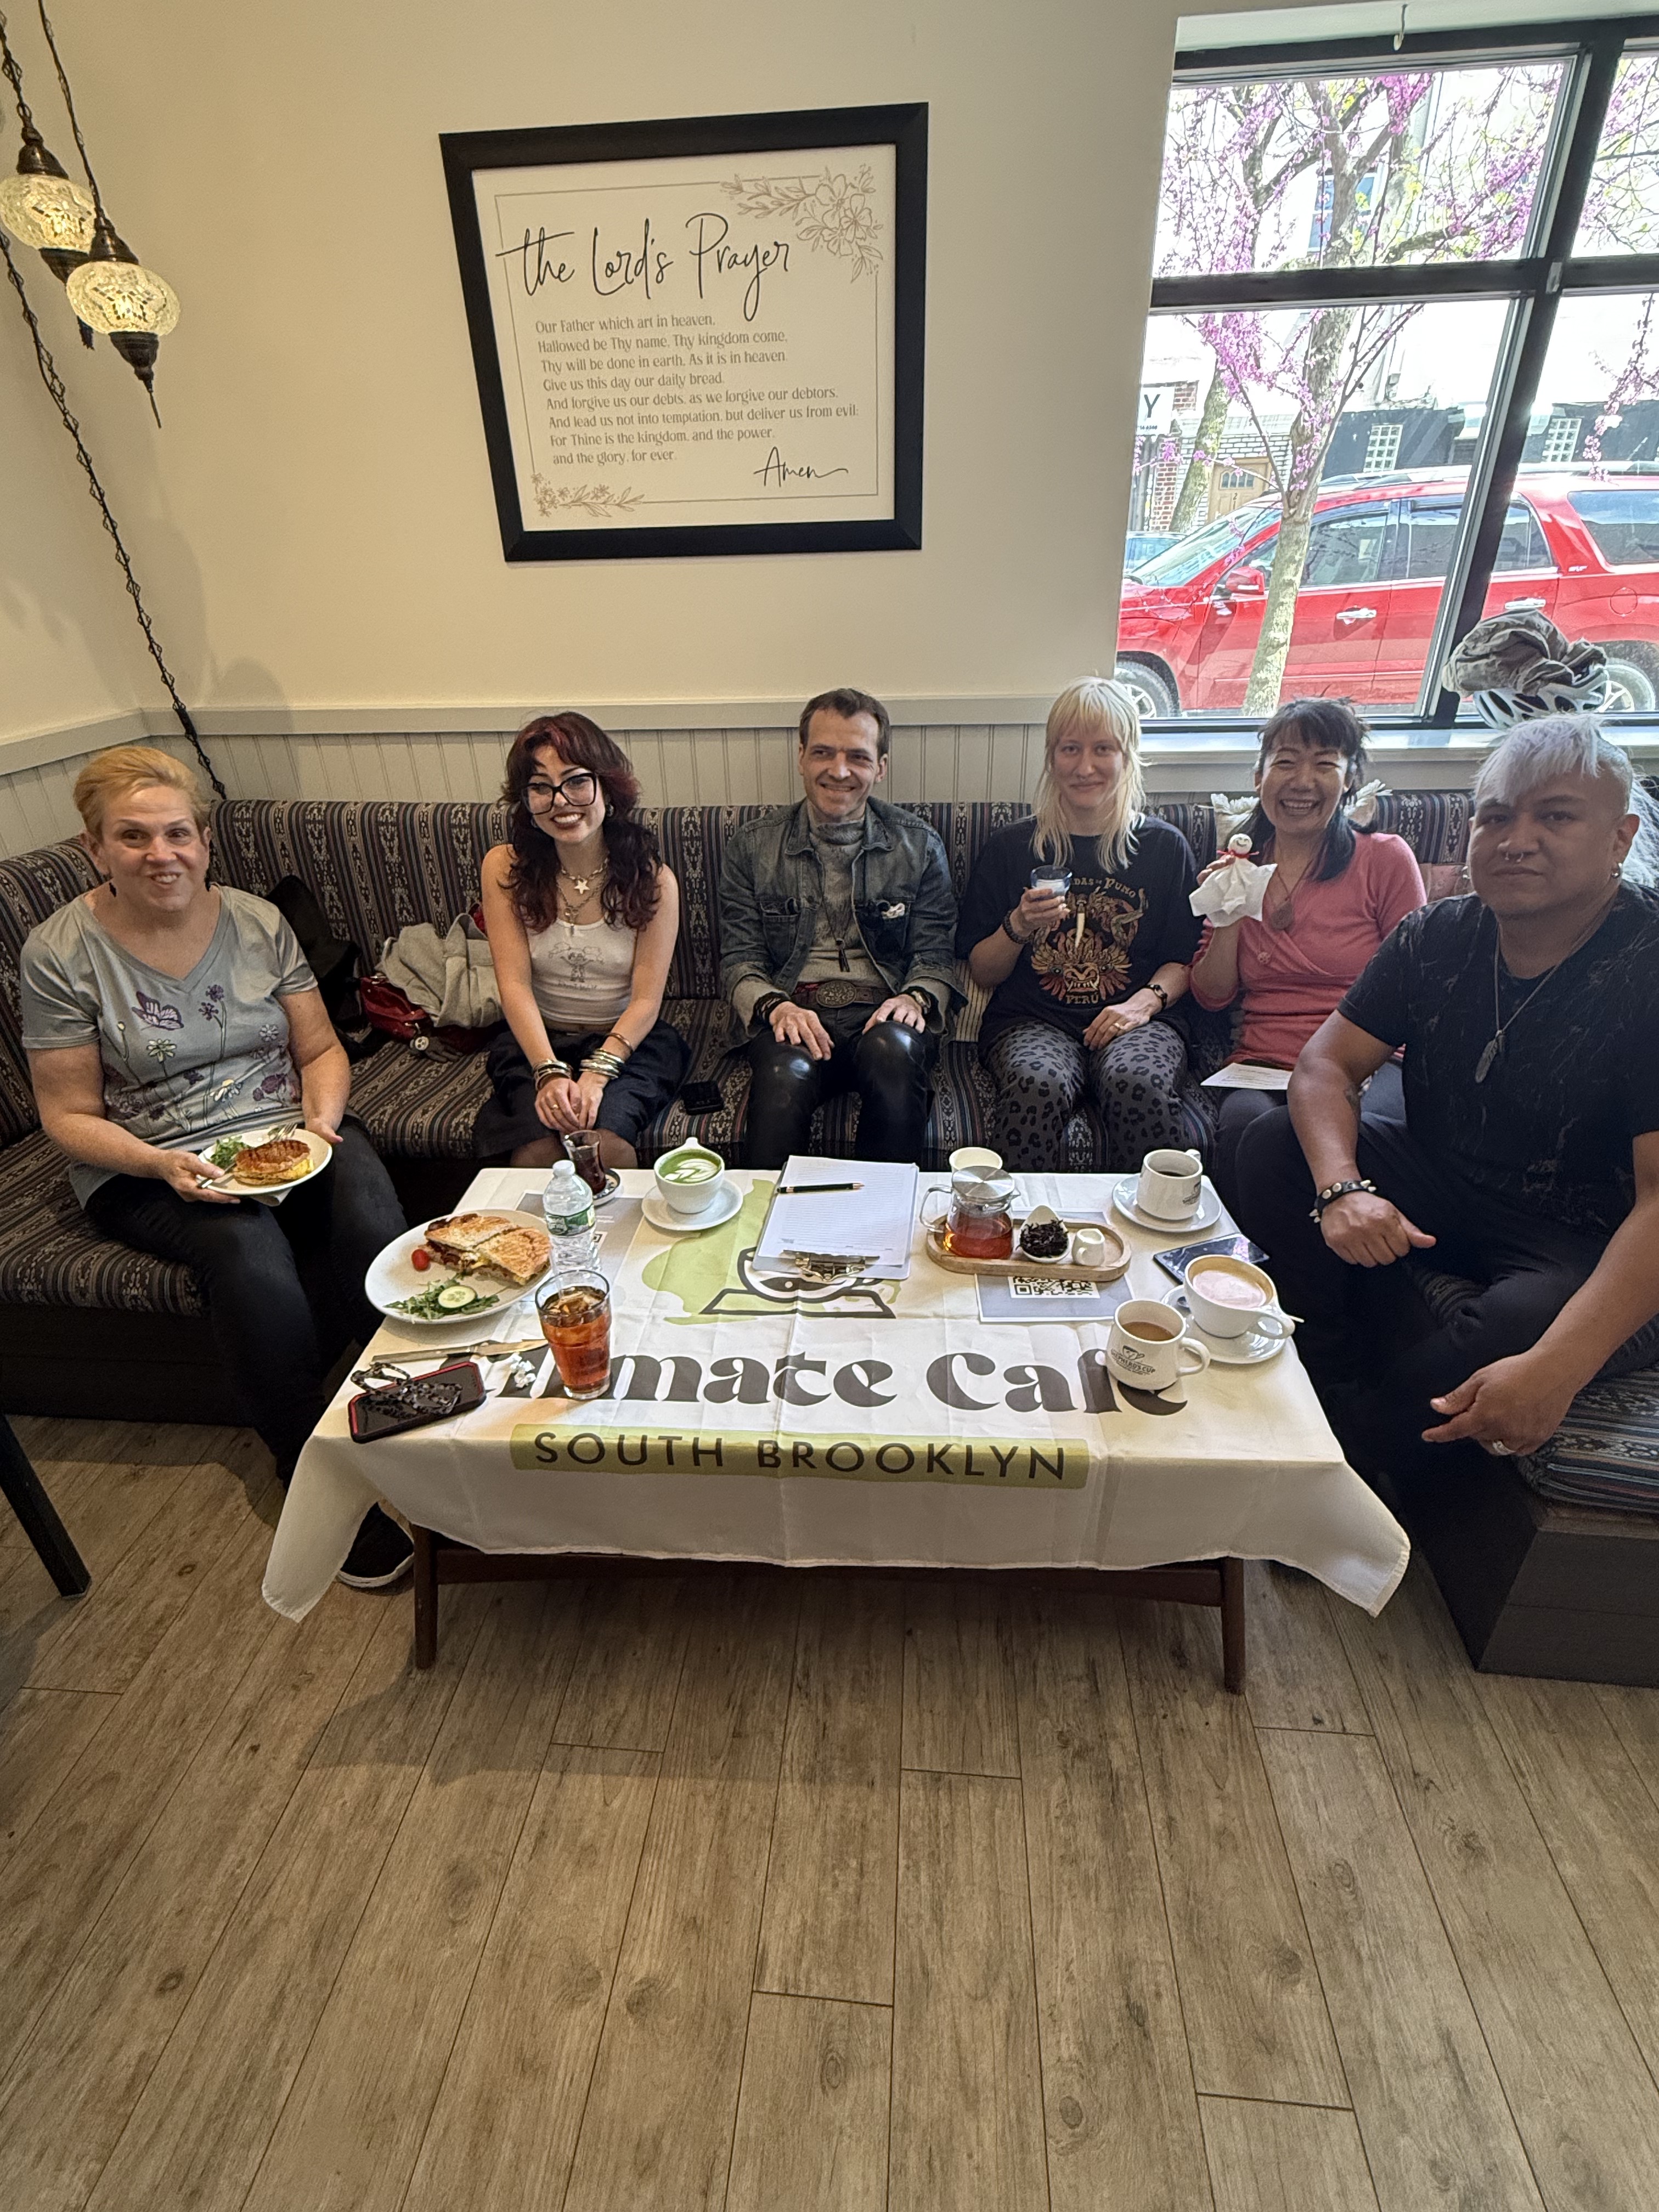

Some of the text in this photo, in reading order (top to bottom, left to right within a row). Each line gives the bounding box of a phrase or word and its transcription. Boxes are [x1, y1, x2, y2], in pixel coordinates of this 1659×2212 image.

[495, 212, 789, 322] the Lord's Prayer
[535, 320, 557, 333] Our
[561, 319, 595, 332] Father
[599, 316, 634, 330] which
[637, 317, 653, 329] art
[657, 314, 668, 327] in
[538, 338, 590, 353] Hallowed
[593, 338, 607, 350] be
[611, 336, 632, 353] Thy
[673, 334, 695, 350] Thy
[698, 331, 749, 349] kingdom
[540, 359, 562, 376] Thy
[566, 358, 586, 371] will
[589, 358, 603, 370] be
[607, 357, 635, 369] done
[639, 355, 650, 368] in
[689, 353, 703, 365] As
[706, 352, 714, 365] it
[716, 351, 727, 364] is
[730, 351, 741, 364] in
[543, 378, 567, 392] Give
[570, 380, 584, 390] us
[586, 376, 607, 389] this
[611, 376, 631, 392] day
[634, 377, 654, 387] our
[658, 373, 686, 388] daily
[547, 397, 568, 410] And
[572, 396, 610, 412] forgive
[613, 397, 627, 407] us
[630, 396, 650, 406] our
[689, 394, 702, 404] as
[706, 393, 723, 403] we
[725, 388, 765, 404] forgive
[768, 390, 788, 400] our
[549, 416, 570, 428] And
[574, 415, 596, 427] lead
[600, 416, 613, 426] us
[616, 415, 634, 425] not
[637, 413, 659, 425] into
[725, 410, 743, 421] but
[747, 407, 786, 420] deliver
[789, 409, 803, 418] us
[806, 405, 832, 418] from
[550, 435, 567, 447] For
[571, 433, 602, 446] Thine
[605, 432, 614, 444] is
[617, 432, 635, 444] the
[692, 428, 713, 441] and
[716, 428, 734, 439] the
[553, 453, 573, 465] and
[577, 453, 594, 464] the
[631, 449, 647, 461] for
[753, 446, 849, 487] Amen
[534, 1432, 1064, 1480] SOUTH BROOKLYN
